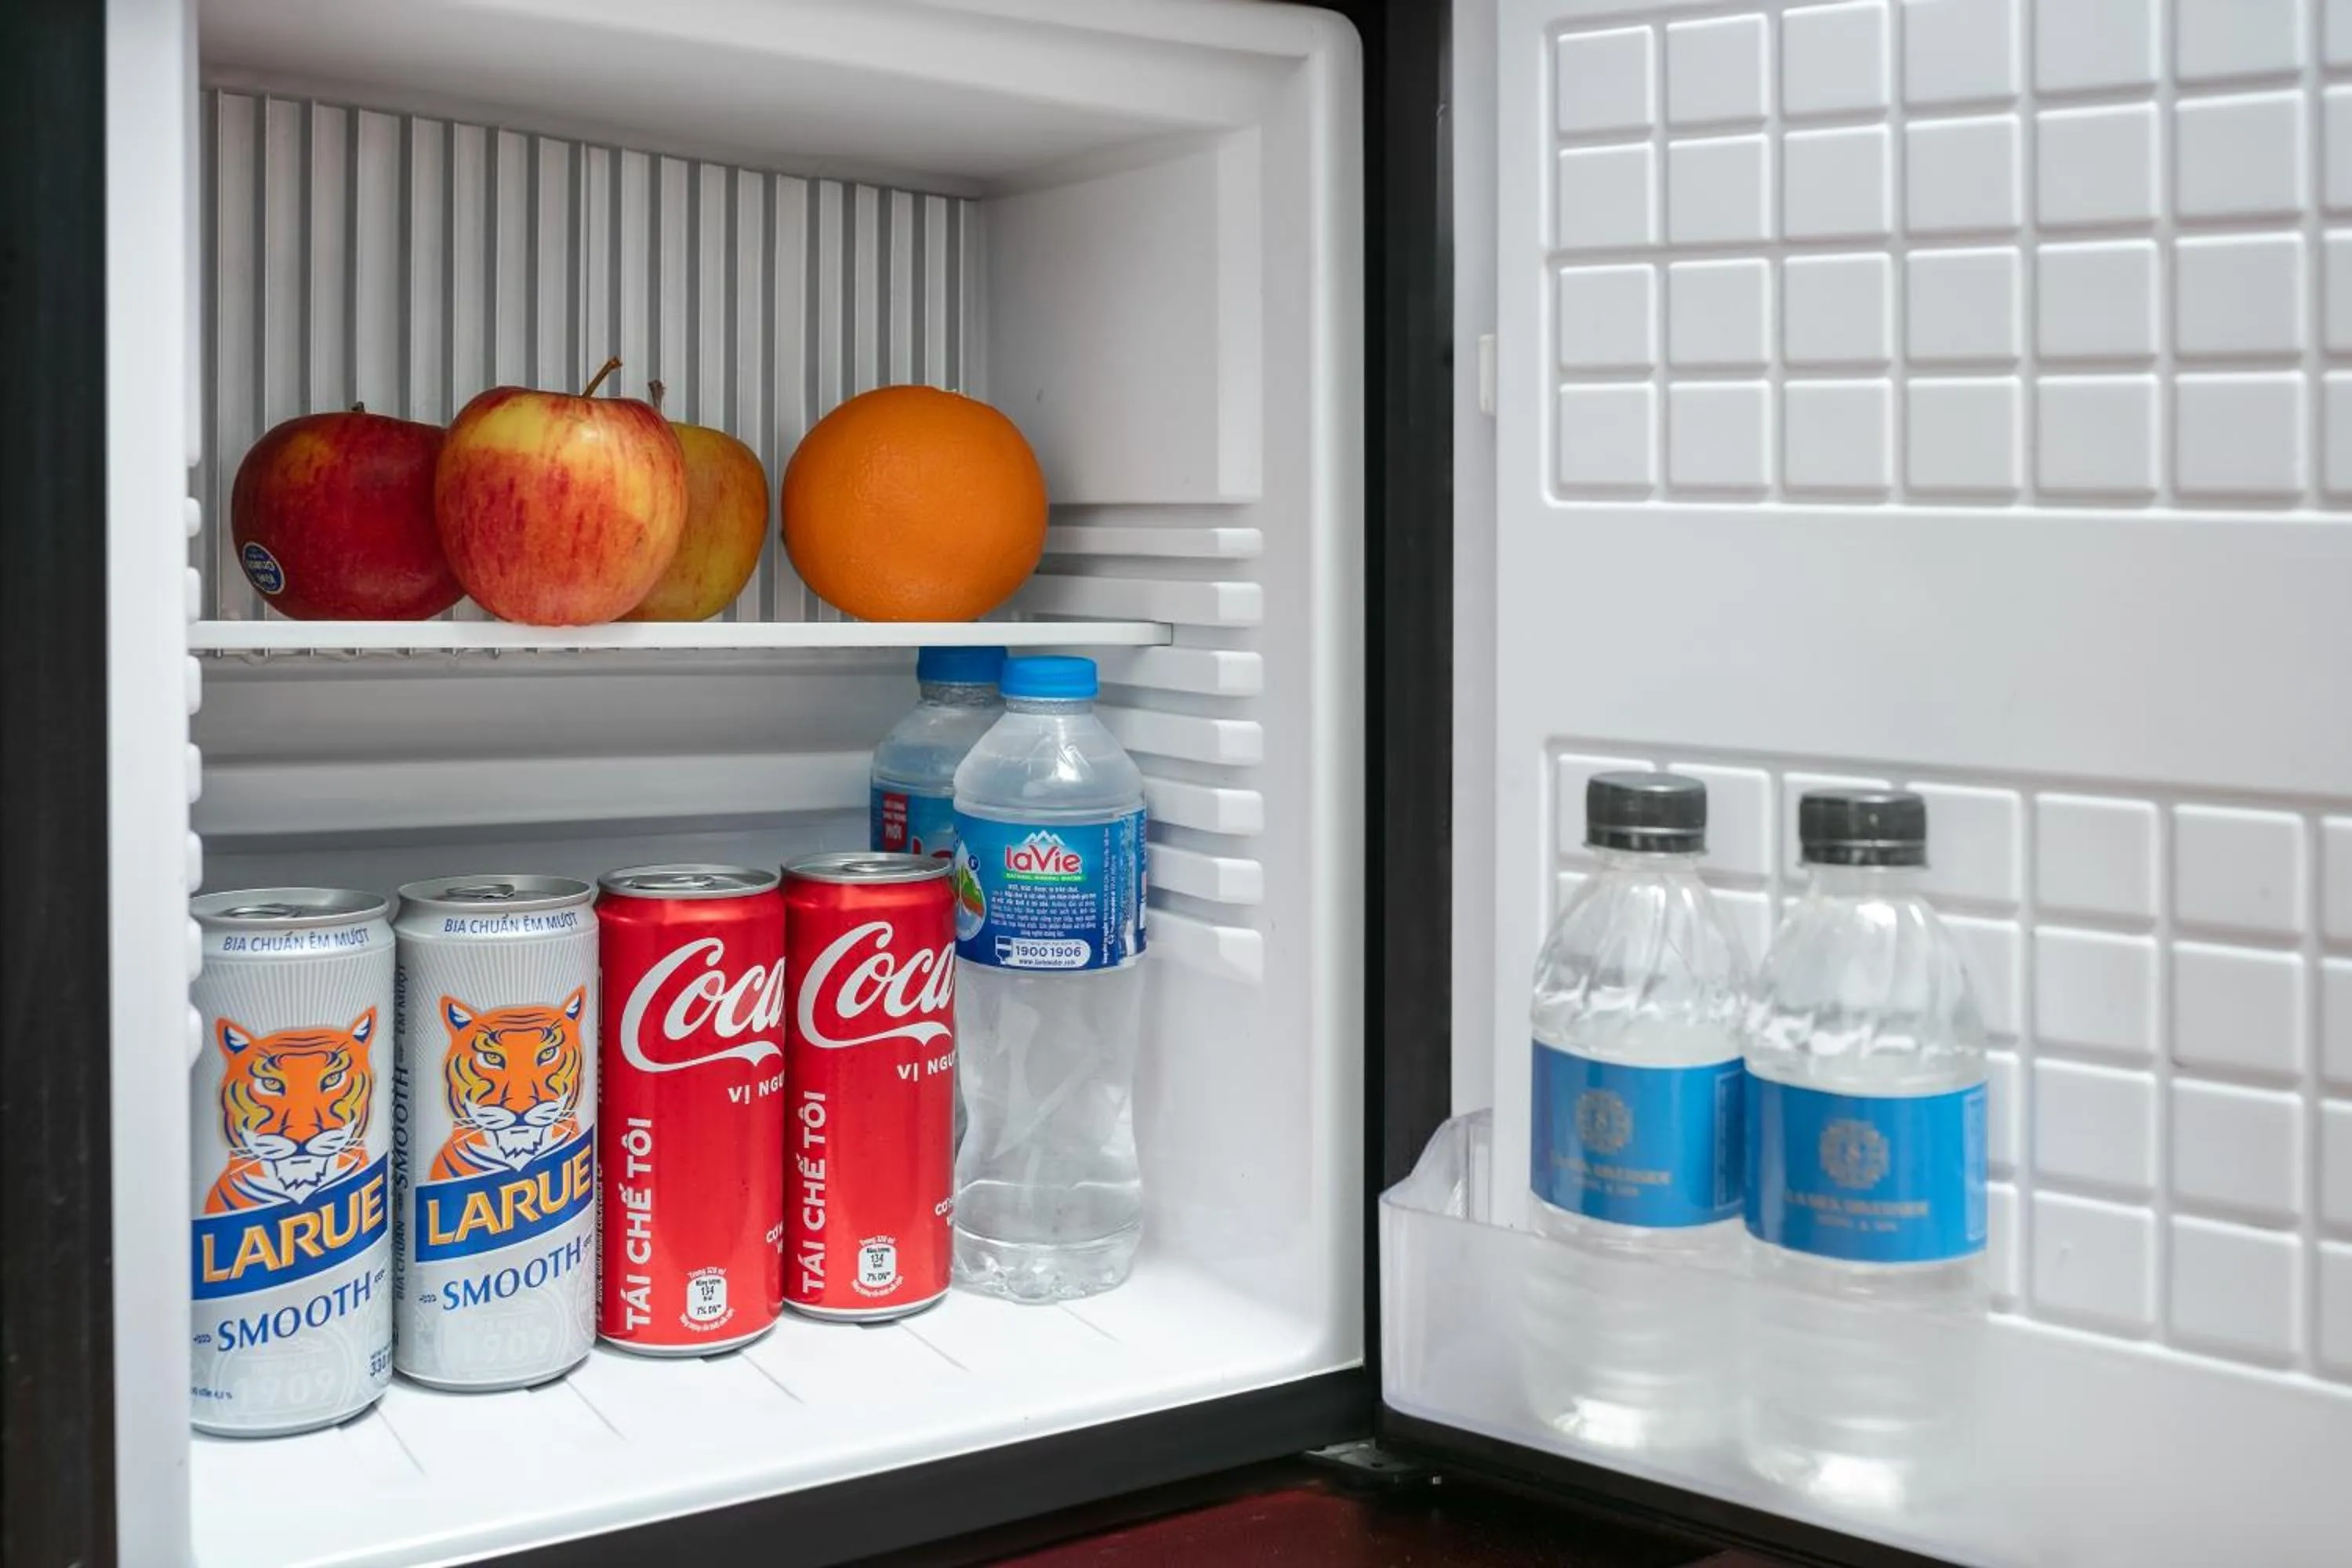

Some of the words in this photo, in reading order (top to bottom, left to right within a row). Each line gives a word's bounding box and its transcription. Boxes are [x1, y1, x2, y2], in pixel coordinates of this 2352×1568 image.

[223, 935, 247, 952] BIA
[310, 931, 330, 949] ÊM
[444, 918, 466, 933] BIA
[523, 915, 543, 932] ÊM
[393, 1065, 408, 1189] SMOOTH
[620, 1117, 652, 1178] TÔI
[797, 1091, 826, 1149] TÔI
[201, 1173, 384, 1283] LARUE
[426, 1144, 592, 1247] LARUE
[618, 1182, 652, 1265] CHẾ
[796, 1152, 826, 1231] CHẾ
[442, 1235, 581, 1312] SMOOTH
[620, 1273, 652, 1330] TÁI
[797, 1240, 826, 1294] TÁI
[217, 1270, 371, 1352] SMOOTH
